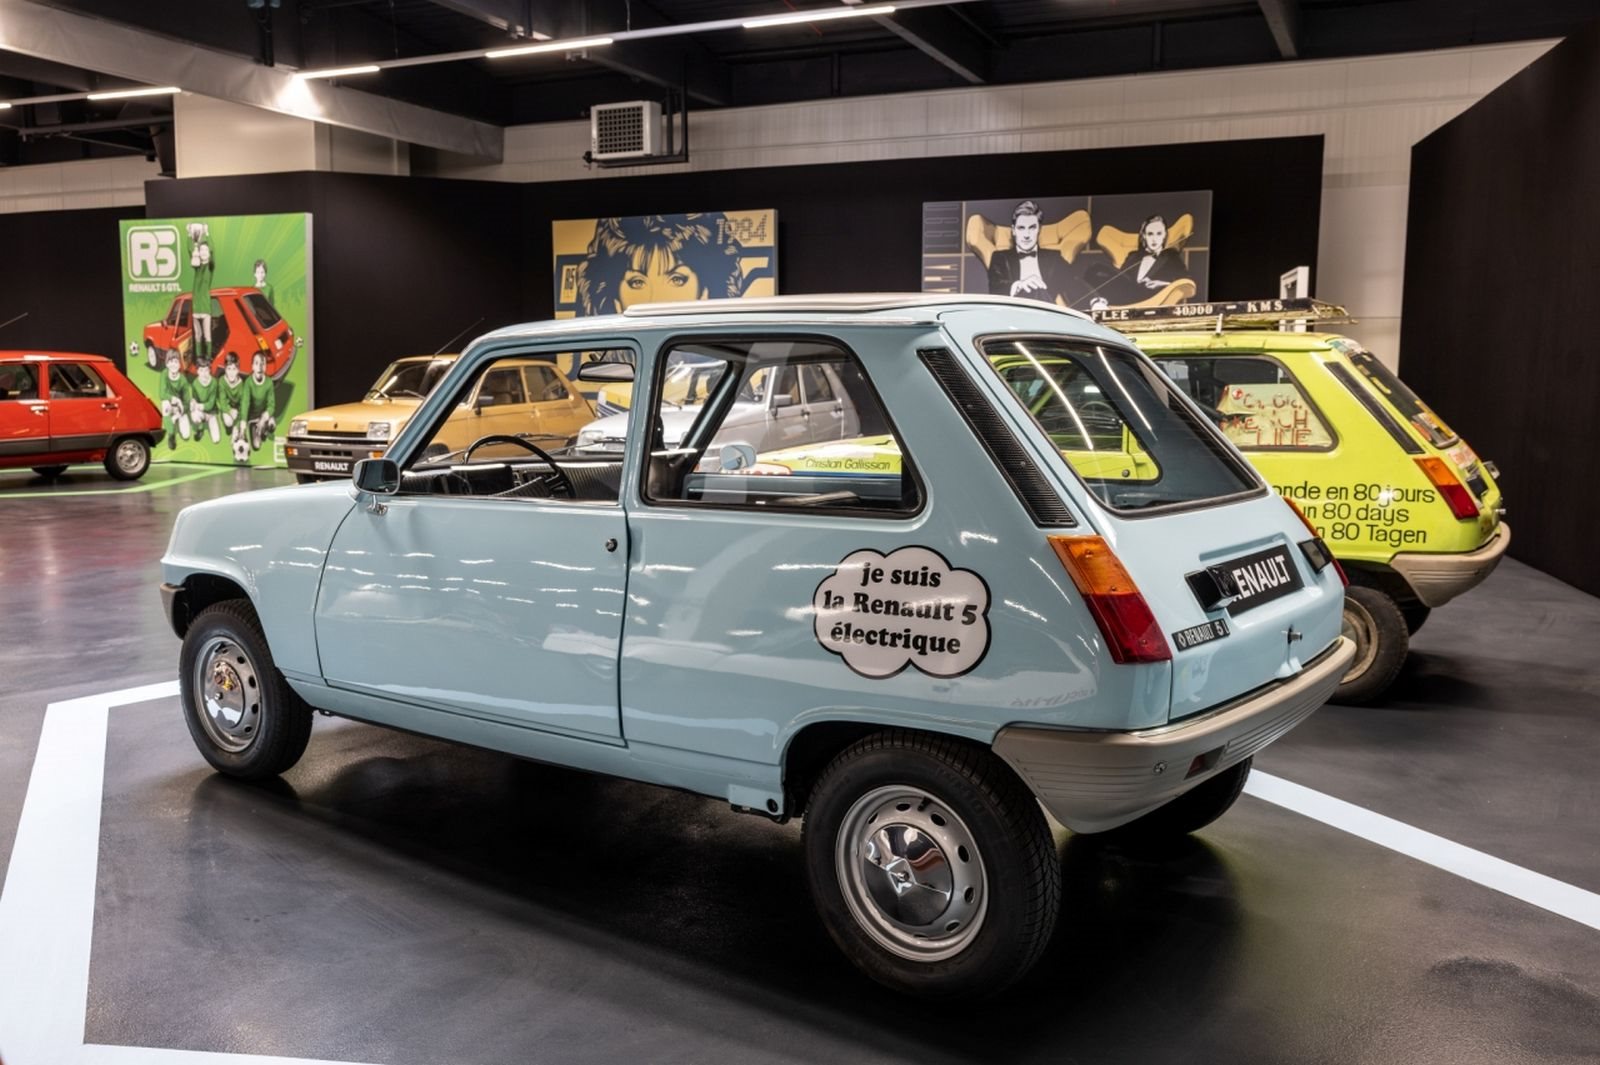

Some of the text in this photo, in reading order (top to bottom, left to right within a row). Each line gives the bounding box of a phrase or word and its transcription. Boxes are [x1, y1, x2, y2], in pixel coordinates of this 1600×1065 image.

[716, 213, 768, 245] 1984
[131, 230, 177, 277] R5
[314, 461, 349, 471] RENAULT
[1325, 485, 1348, 500] en
[1353, 483, 1381, 501] 80
[1378, 484, 1436, 508] jours
[1322, 502, 1351, 520] 80
[1356, 503, 1409, 527] days
[1331, 522, 1360, 541] 80
[1366, 524, 1427, 548] Tagen
[860, 562, 941, 588] je suis
[1231, 554, 1290, 602] ENAULT
[821, 590, 978, 626] la Renault 5
[830, 621, 961, 656] électrique
[1184, 623, 1214, 646] RENAULT
